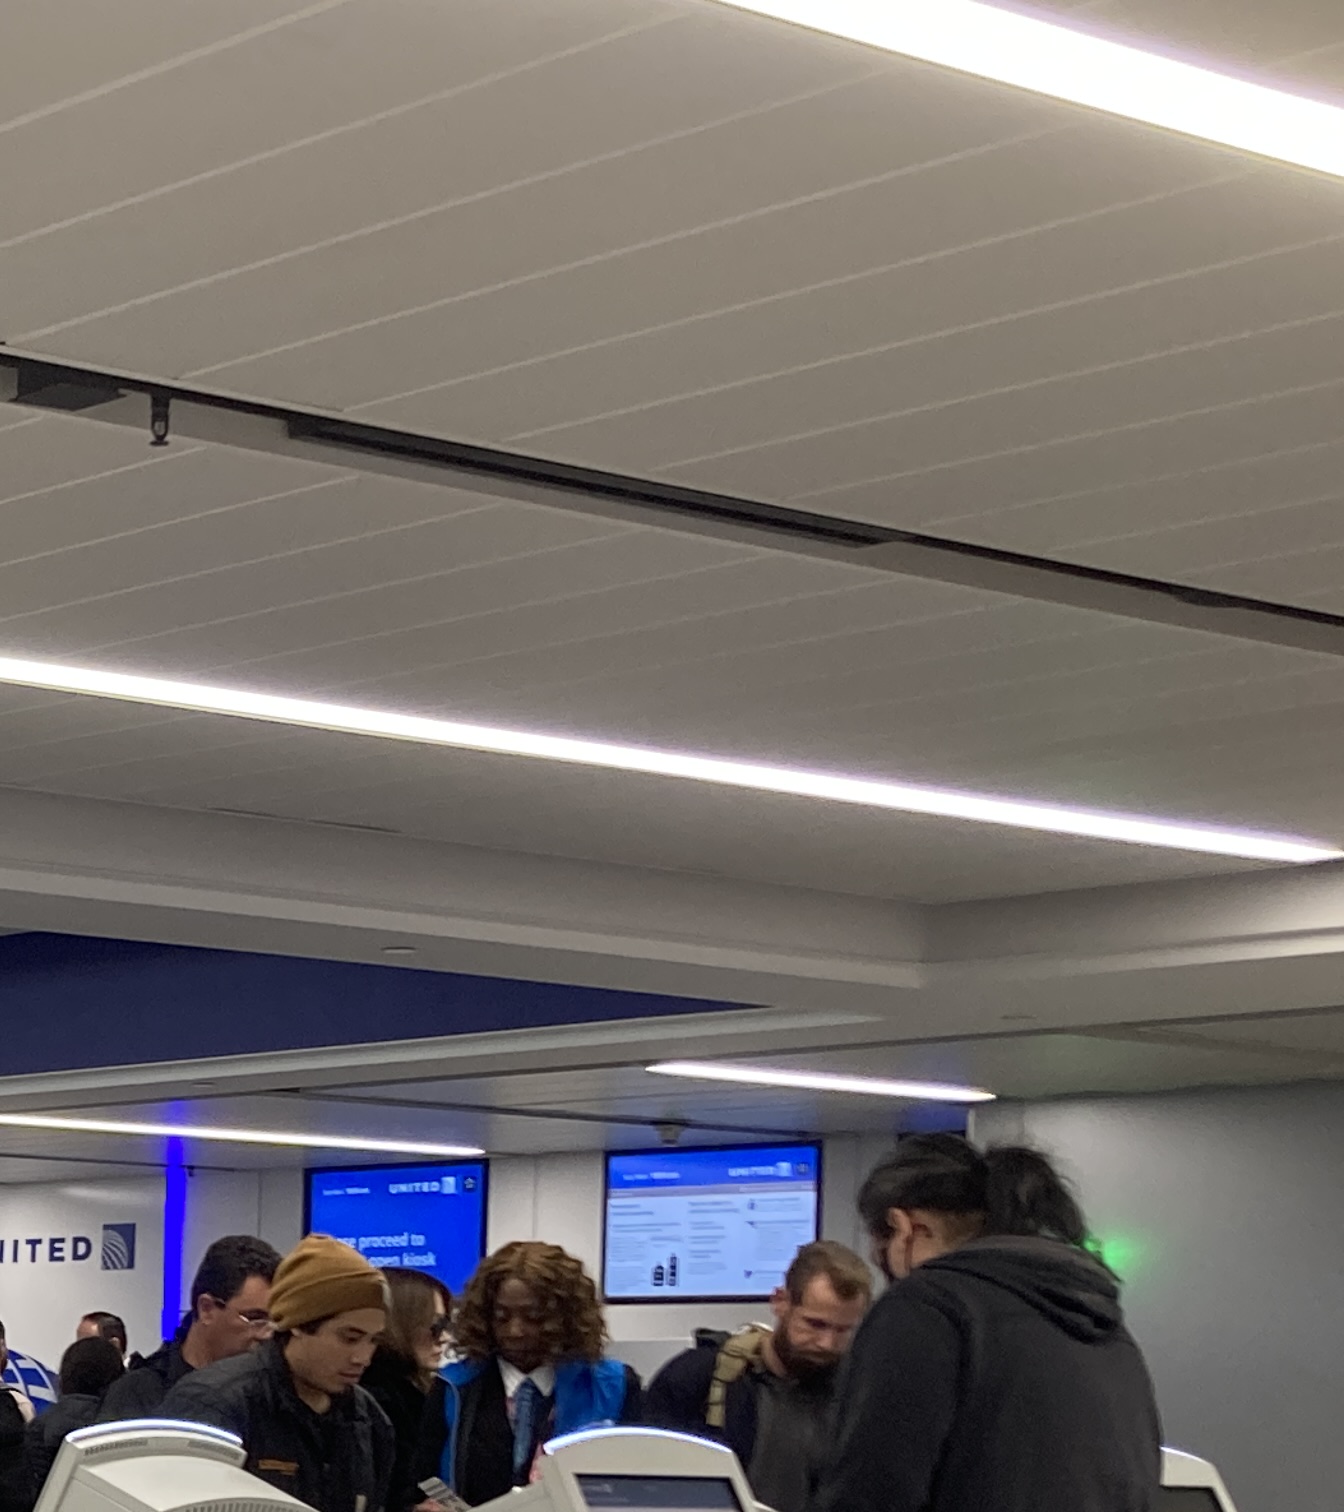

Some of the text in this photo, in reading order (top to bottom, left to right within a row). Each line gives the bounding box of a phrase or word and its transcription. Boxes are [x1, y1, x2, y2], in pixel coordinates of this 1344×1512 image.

[388, 1181, 440, 1194] UNITED
[358, 1232, 409, 1253] proceed
[411, 1233, 426, 1246] to
[402, 1251, 436, 1267] kiosk
